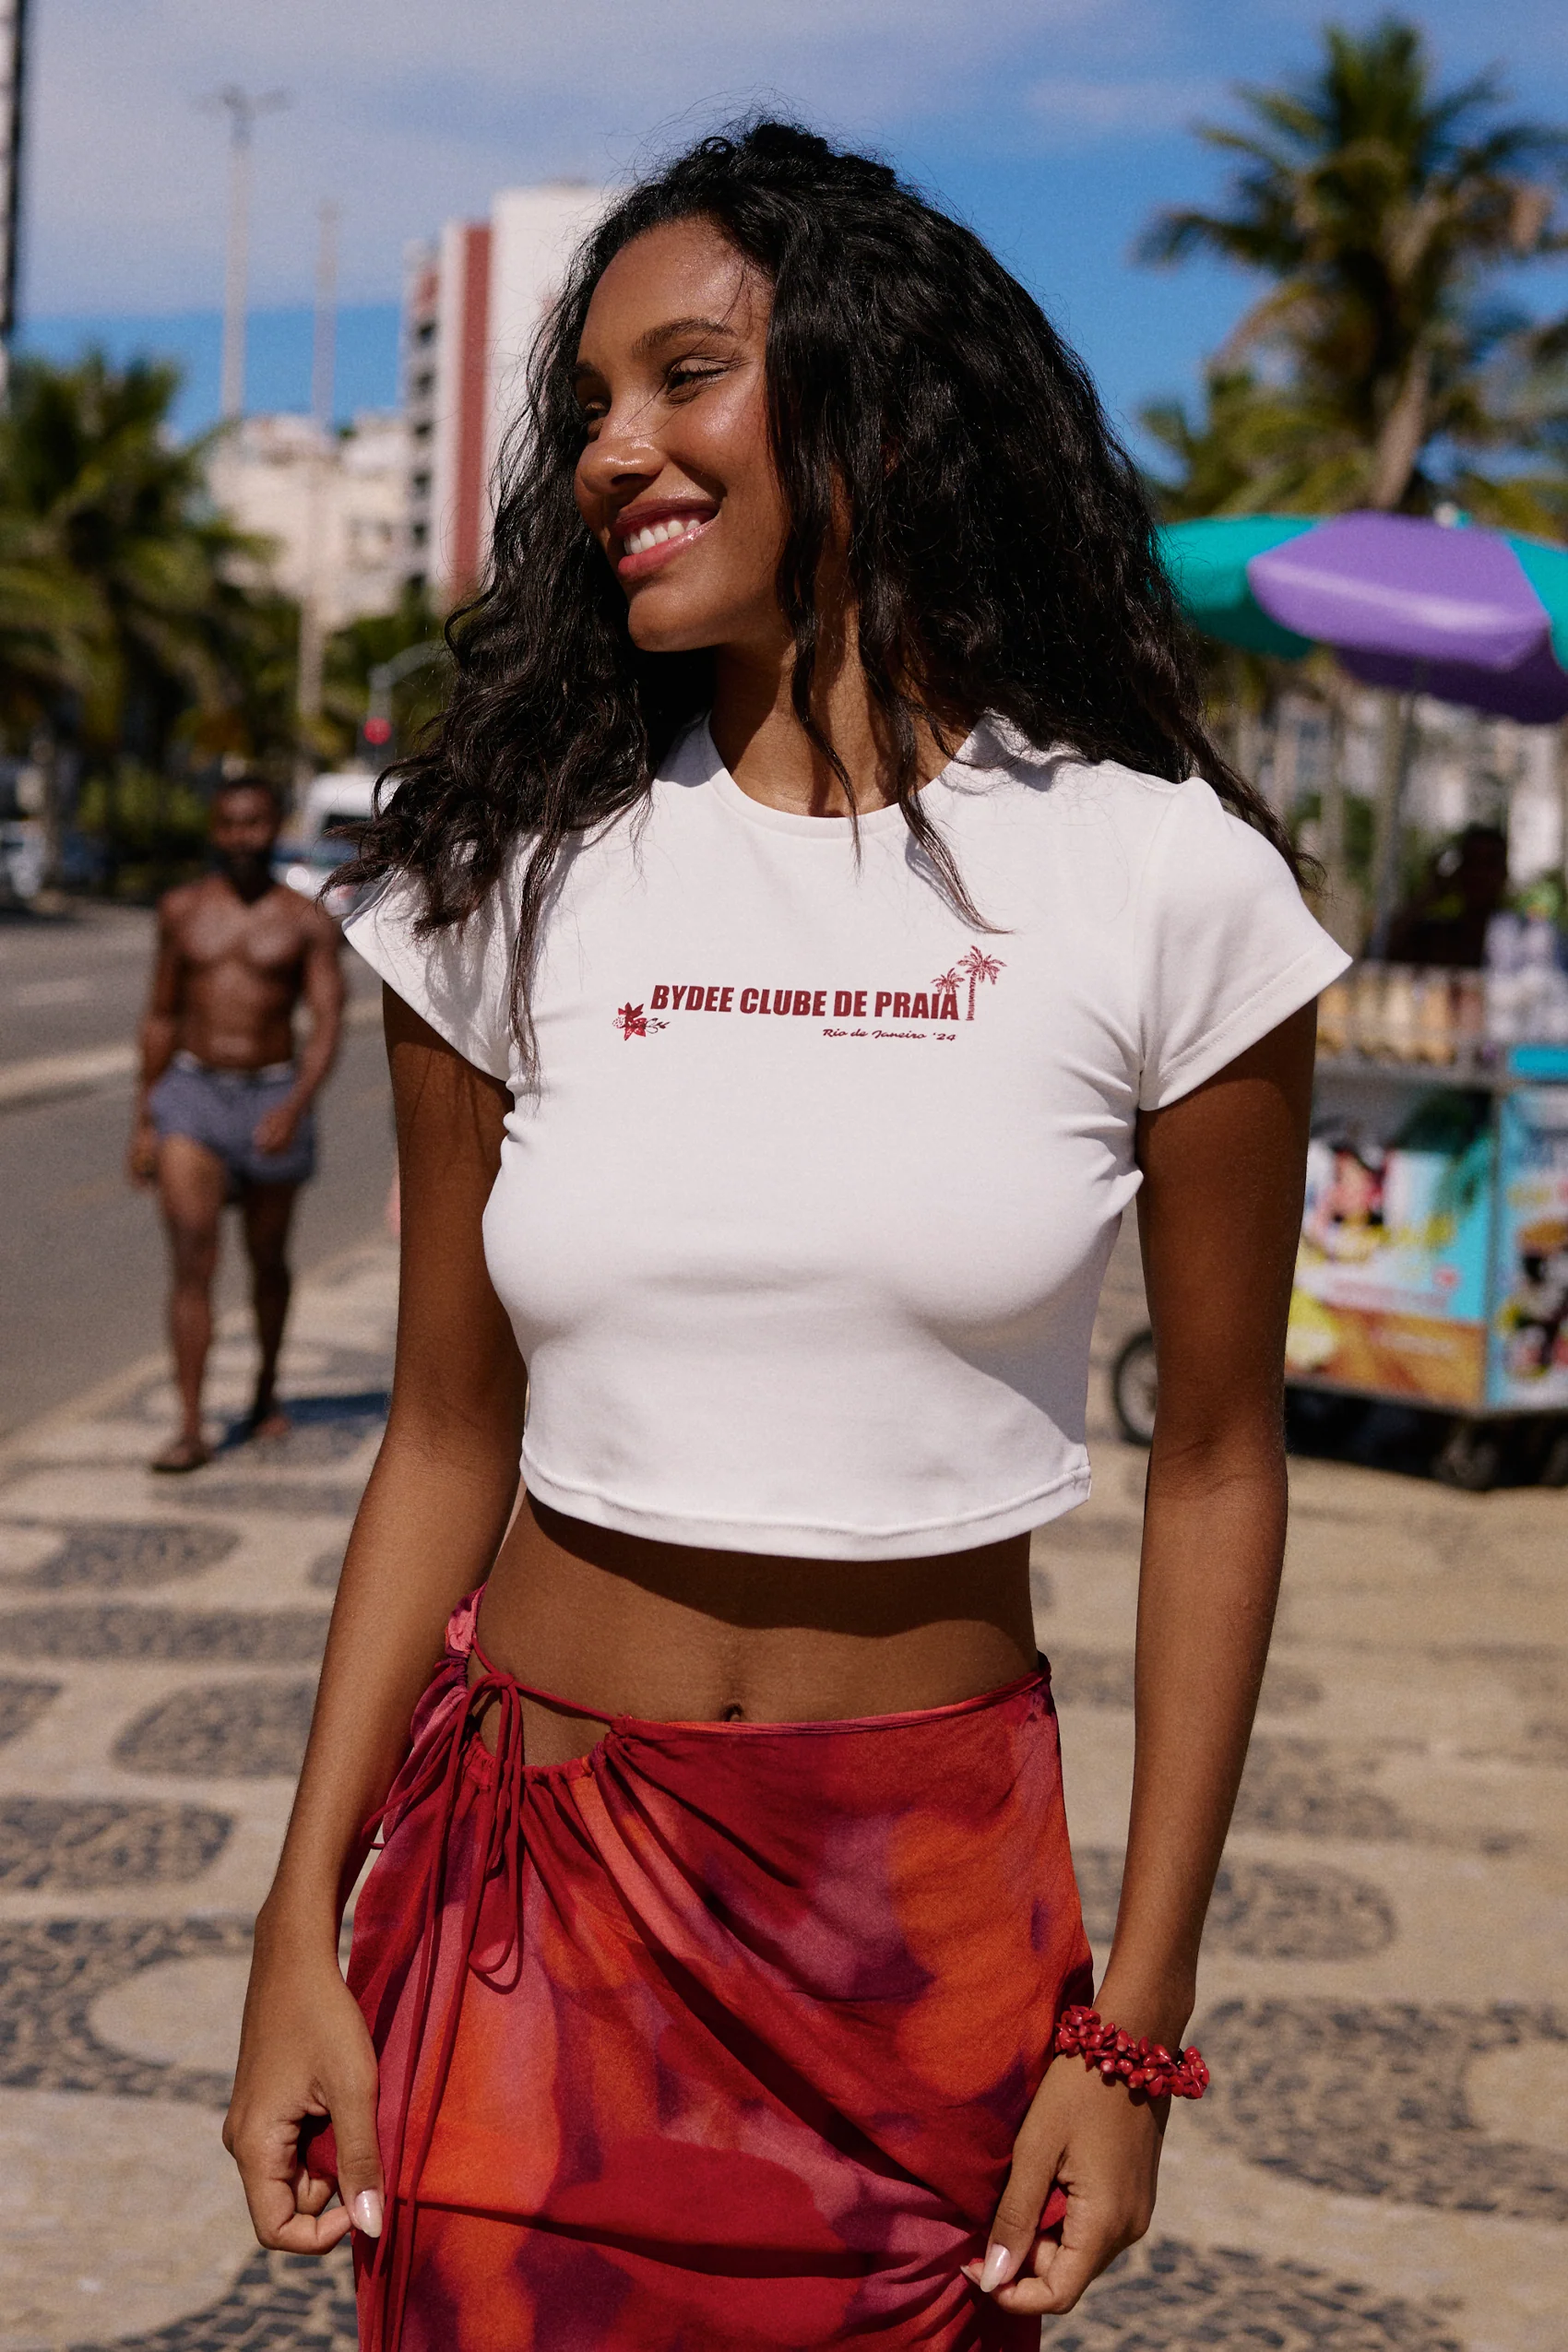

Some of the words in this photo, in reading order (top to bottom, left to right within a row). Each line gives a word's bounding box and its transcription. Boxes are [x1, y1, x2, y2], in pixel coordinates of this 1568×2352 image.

[650, 984, 735, 1013] BYDEE
[739, 987, 827, 1017] CLUBE
[833, 990, 868, 1017] DE
[874, 992, 959, 1021] PRAIA
[822, 1028, 849, 1038] Rio
[849, 1028, 869, 1038] de
[871, 1029, 927, 1039] Janeiro
